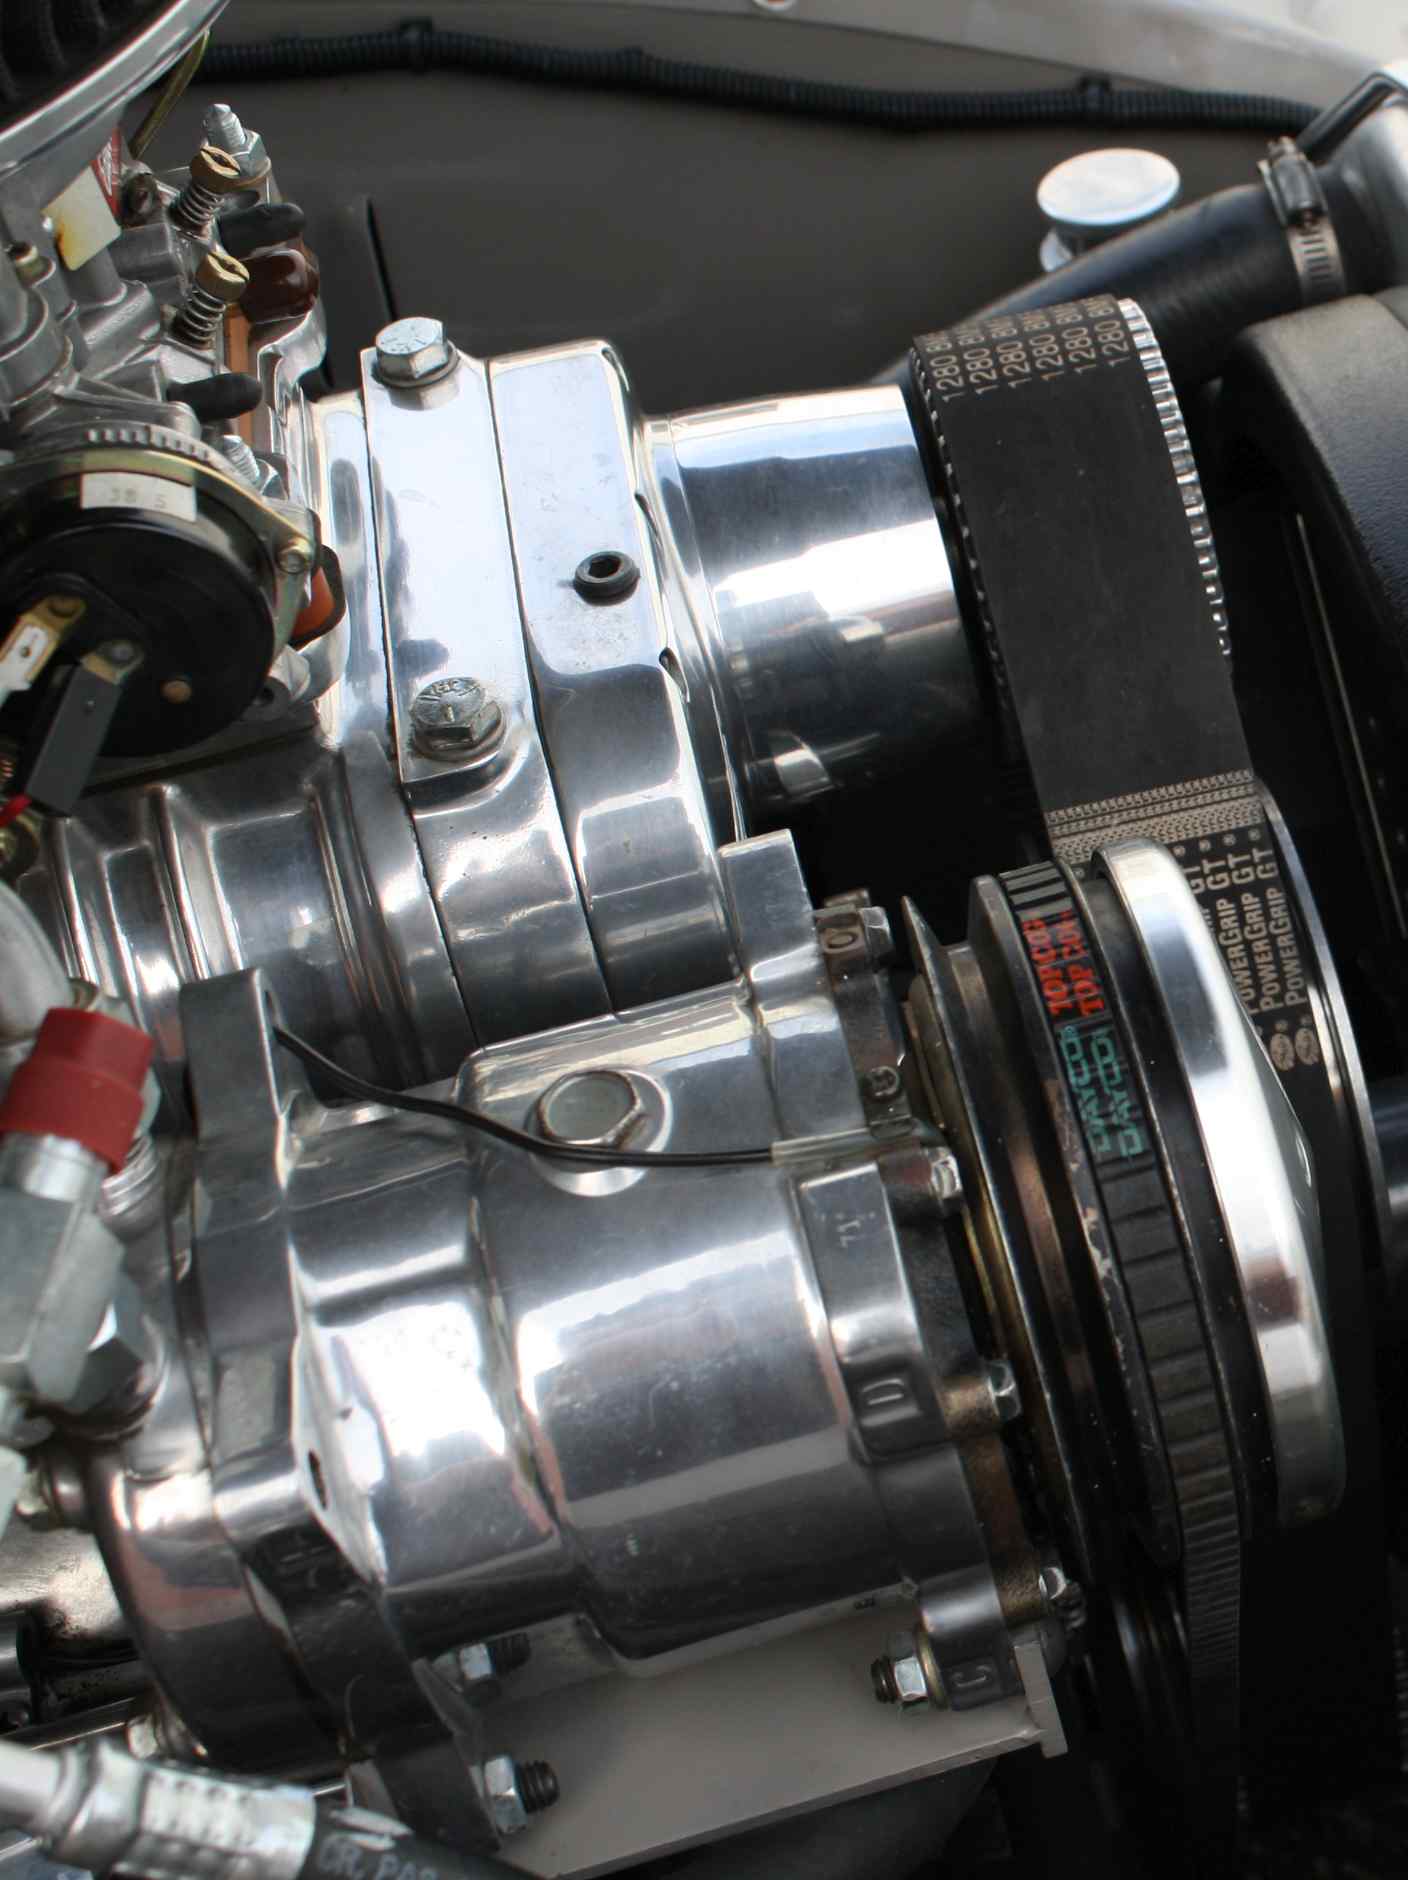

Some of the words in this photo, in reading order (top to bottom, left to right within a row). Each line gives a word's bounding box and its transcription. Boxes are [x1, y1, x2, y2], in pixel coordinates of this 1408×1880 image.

[996, 341, 1032, 388] 1280
[1029, 334, 1064, 380] 1280
[1062, 327, 1096, 374] 1280
[1094, 320, 1130, 367] 1280
[930, 355, 965, 402] 1280
[963, 348, 999, 394] 1280
[1202, 858, 1230, 890] GT
[1228, 853, 1257, 884] GT
[1253, 847, 1279, 878] GT
[1241, 893, 1284, 1011] POWERGRIP
[1266, 887, 1308, 1006] POWERGRIP
[1066, 965, 1105, 1017] TOP
